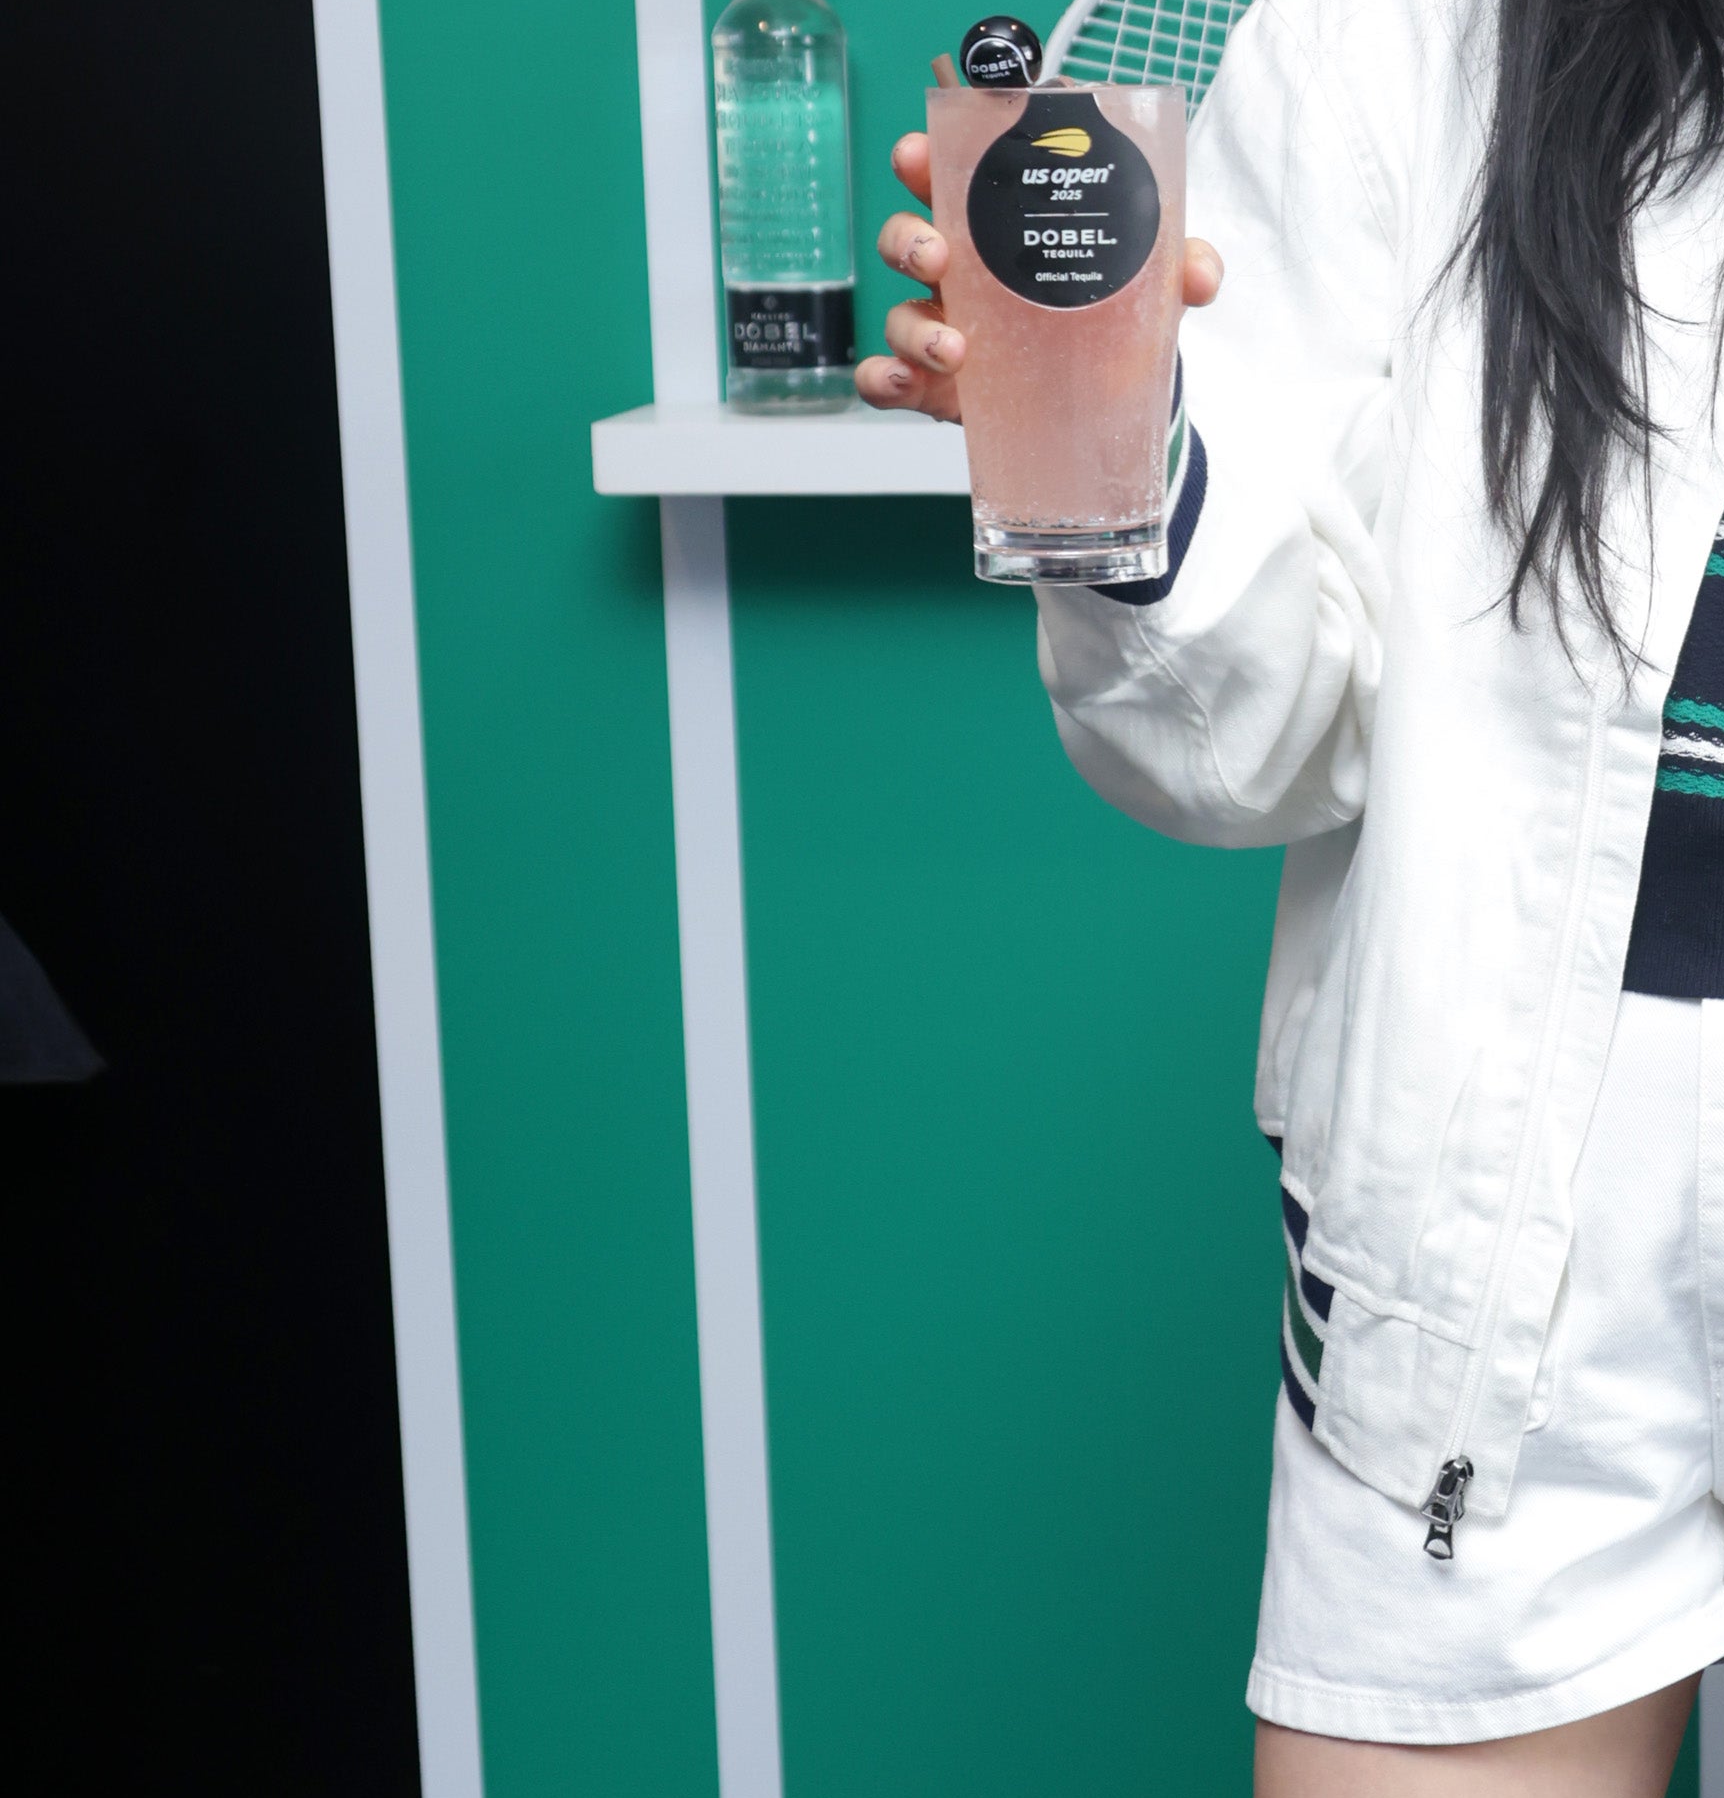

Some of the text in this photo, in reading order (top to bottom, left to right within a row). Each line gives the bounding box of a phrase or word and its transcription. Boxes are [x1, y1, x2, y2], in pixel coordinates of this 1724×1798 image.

[1022, 168, 1050, 184] us
[1050, 190, 1083, 200] 2025
[1042, 249, 1094, 259] TEQUILA
[1035, 272, 1103, 282] Official Tequila
